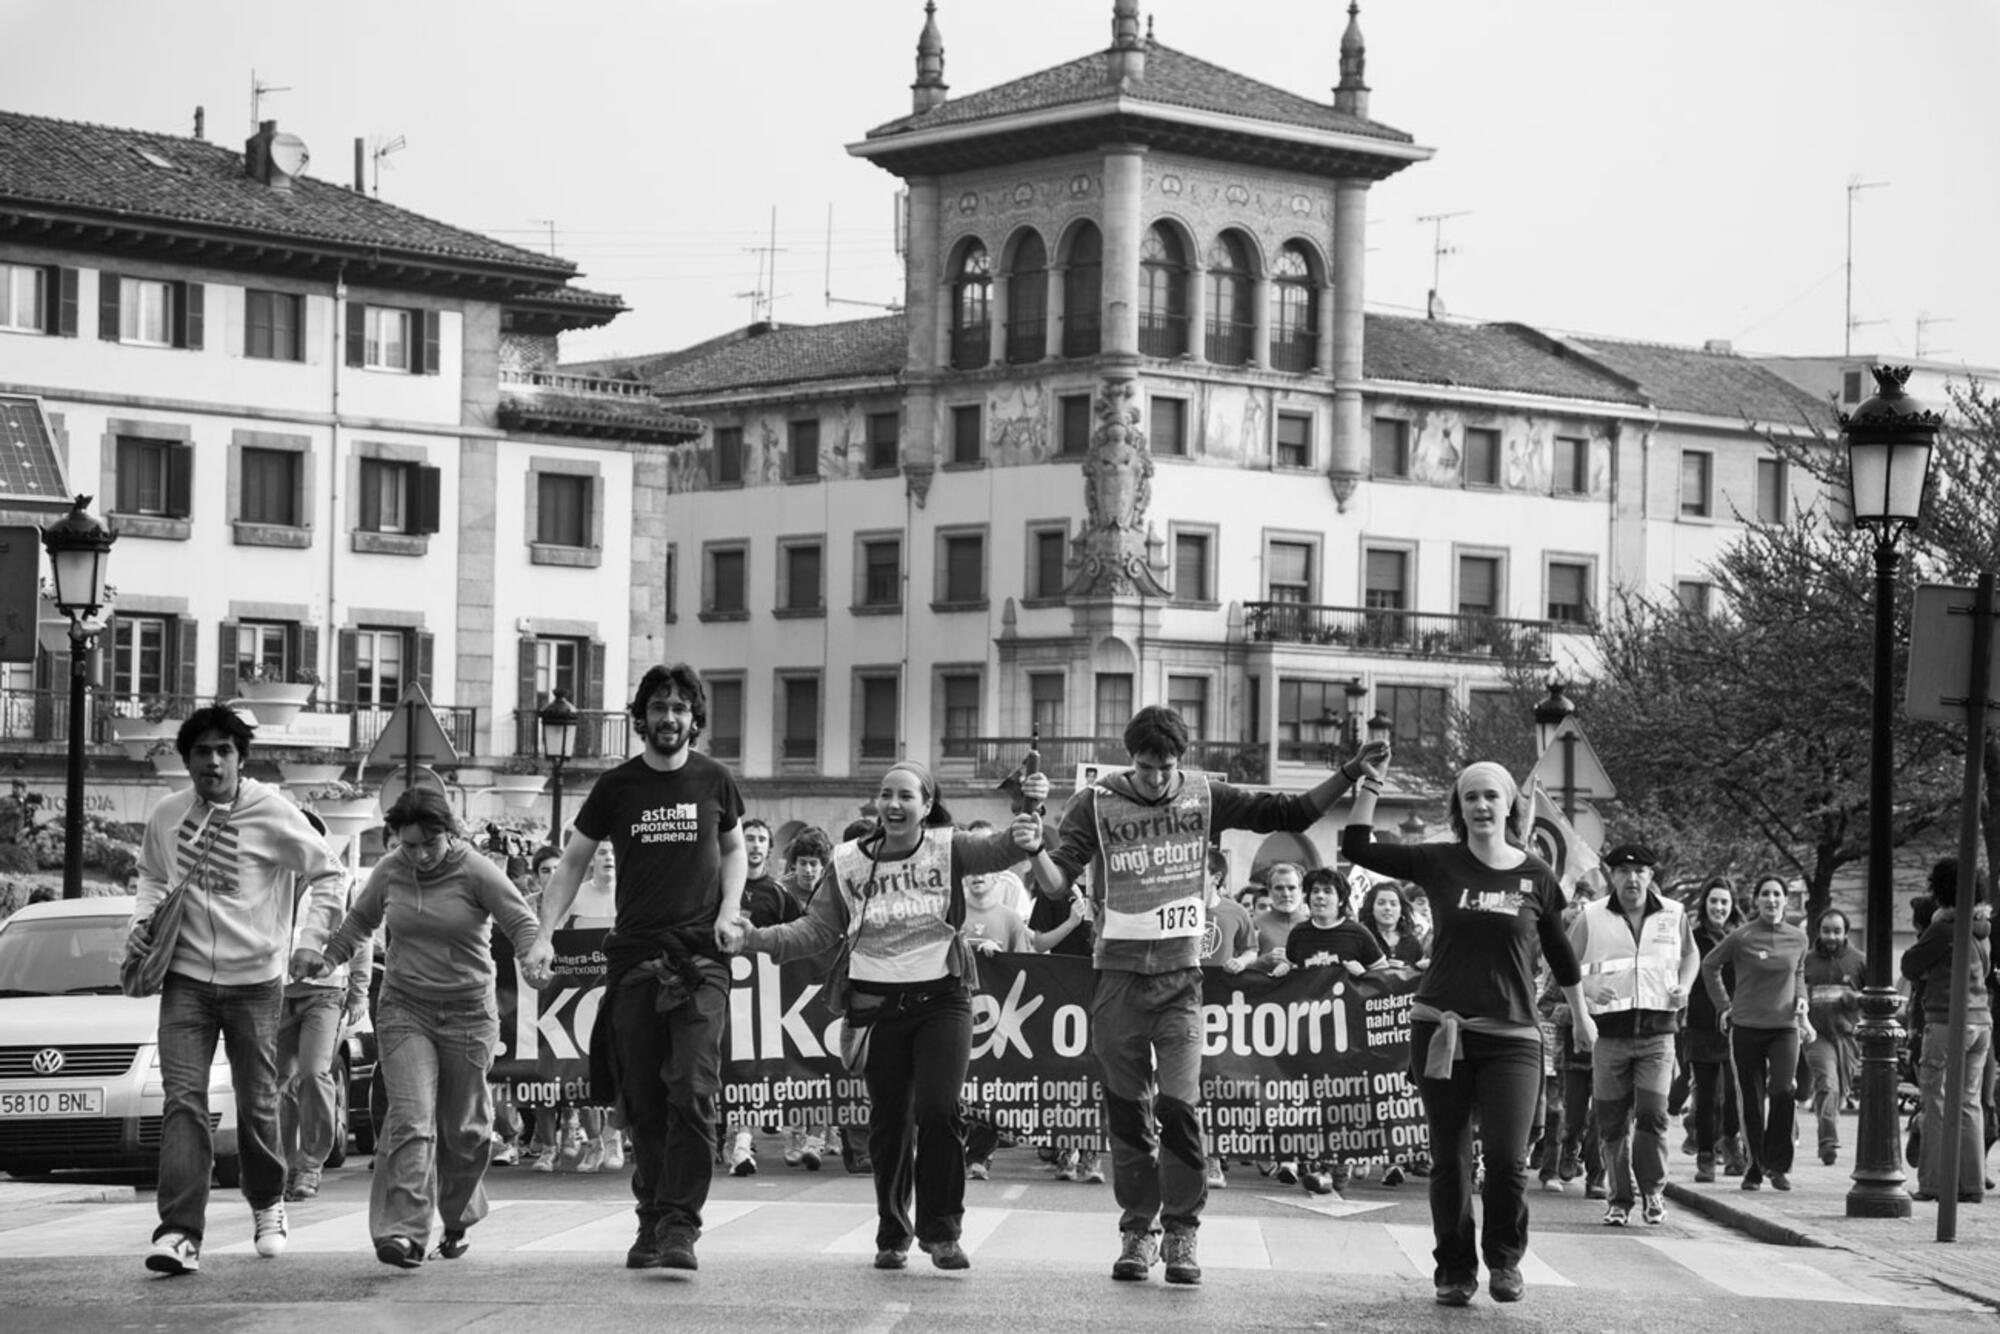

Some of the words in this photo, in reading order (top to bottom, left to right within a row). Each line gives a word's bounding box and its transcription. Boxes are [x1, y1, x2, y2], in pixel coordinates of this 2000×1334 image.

[1103, 808, 1203, 843] korrika
[1111, 844, 1149, 875] ongi
[1154, 836, 1203, 866] etorri
[1156, 905, 1198, 930] 1873
[1201, 981, 1349, 1057] etorri
[1366, 1010, 1394, 1029] nahi
[2, 1094, 49, 1113] 5810
[58, 1093, 94, 1112] BNL
[516, 1076, 561, 1107] ongi
[724, 1076, 770, 1109] ongi
[773, 1073, 831, 1100] etorri
[982, 1076, 1038, 1102] etorri
[1042, 1075, 1087, 1108] ongi
[1202, 1074, 1261, 1101] etorri
[1265, 1073, 1309, 1107] ongi
[1312, 1070, 1369, 1099] etorri
[1374, 1071, 1418, 1098] ong
[726, 1102, 784, 1128] etorri
[837, 1100, 871, 1126] eto
[995, 1102, 1040, 1135] ongi
[1042, 1102, 1101, 1129] etorri
[1217, 1101, 1261, 1133] ongi
[1264, 1100, 1322, 1128] etorri
[1327, 1097, 1372, 1130] ongi
[1217, 1127, 1275, 1154] etorri
[1279, 1127, 1325, 1159] ongi
[1328, 1122, 1387, 1153] etorri
[1391, 1123, 1430, 1150] ong
